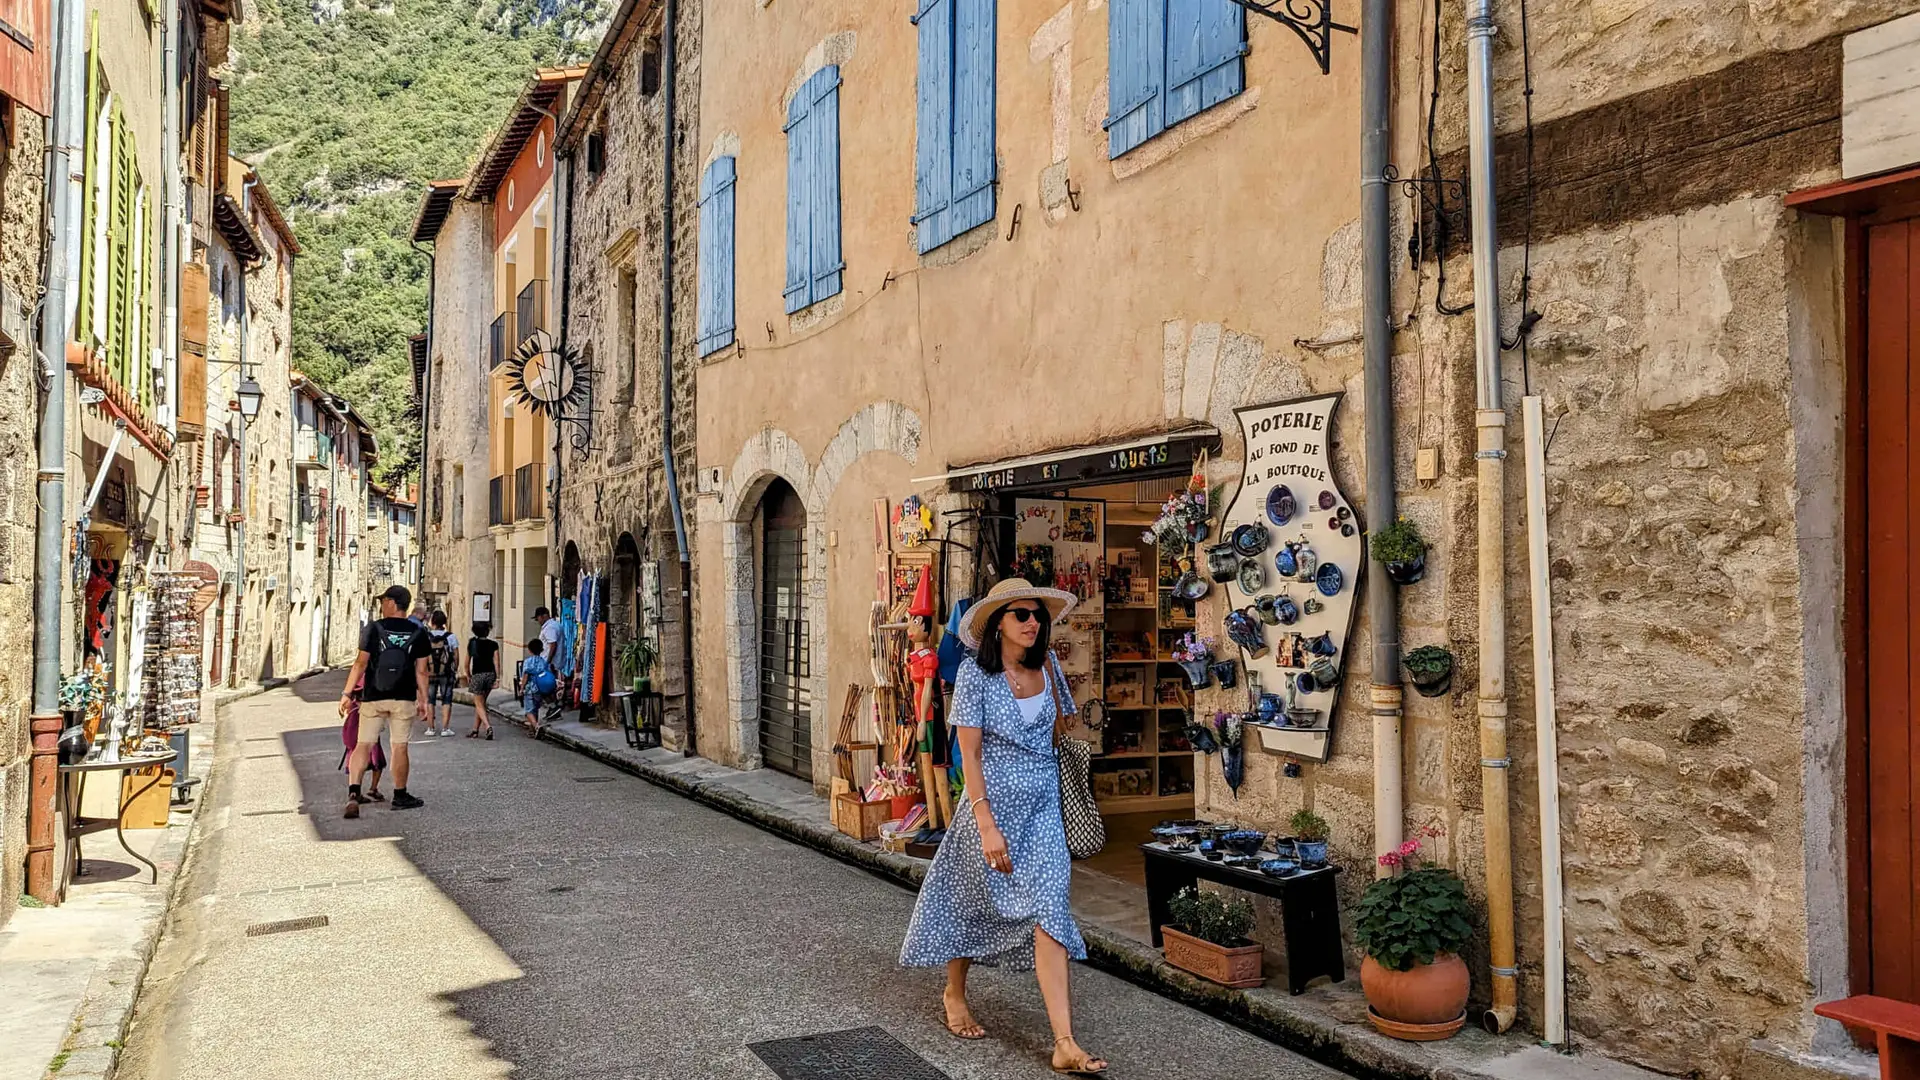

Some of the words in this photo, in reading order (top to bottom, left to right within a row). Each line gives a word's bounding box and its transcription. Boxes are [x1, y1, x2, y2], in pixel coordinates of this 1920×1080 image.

[1251, 412, 1324, 439] POTERIE
[1249, 447, 1264, 463] AU
[1269, 442, 1298, 455] FOND
[1303, 443, 1320, 455] DE
[971, 468, 1014, 489] POTERIE
[1109, 444, 1168, 470] JOUETS
[1246, 473, 1260, 486] LA
[1267, 464, 1326, 482] BOUTIQUE
